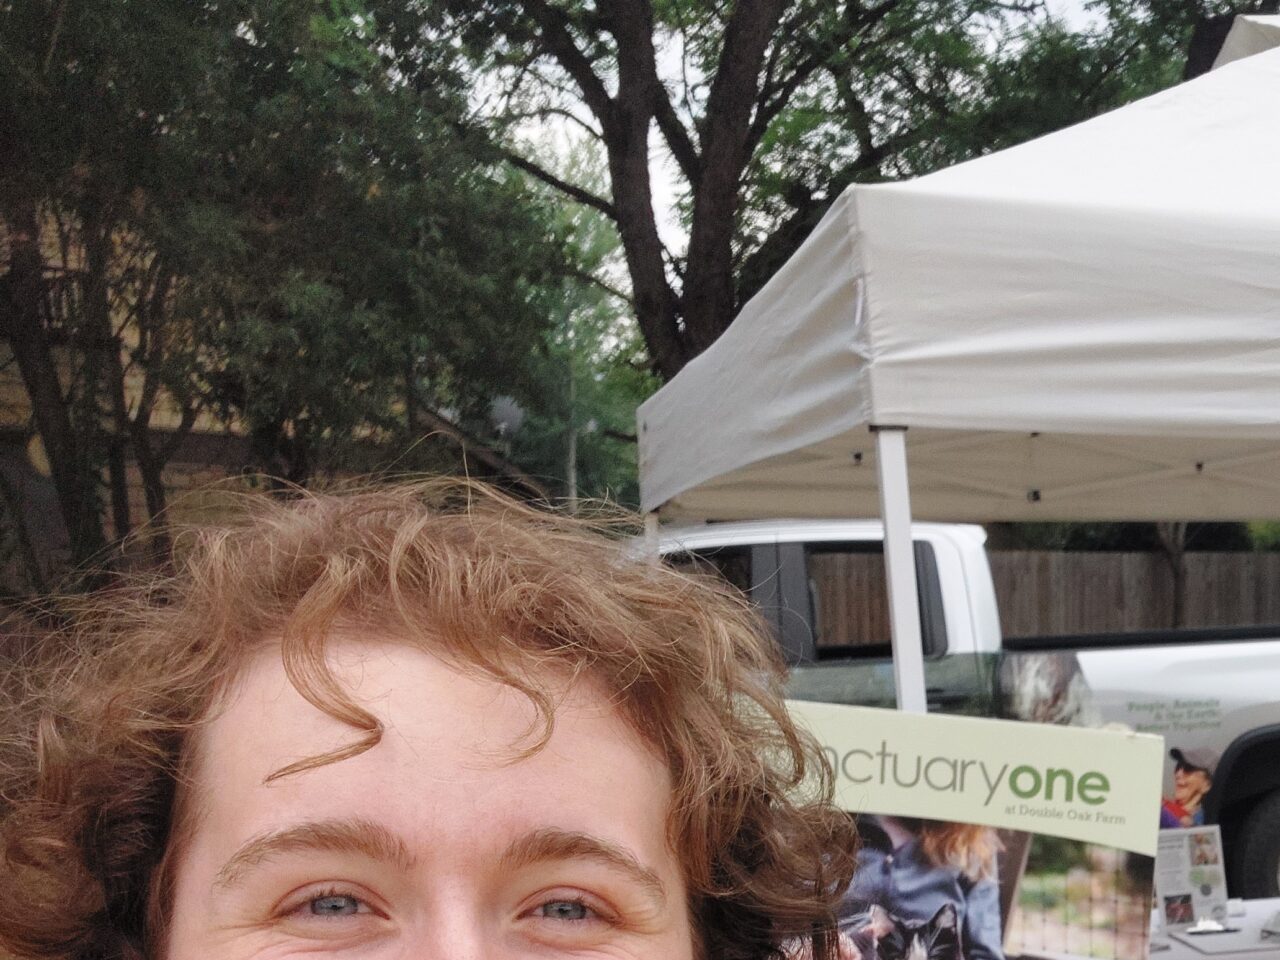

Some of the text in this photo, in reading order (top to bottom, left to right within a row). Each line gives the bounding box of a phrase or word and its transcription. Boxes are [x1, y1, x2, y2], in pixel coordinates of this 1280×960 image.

[1005, 803, 1127, 825] at Double Oak Farm
